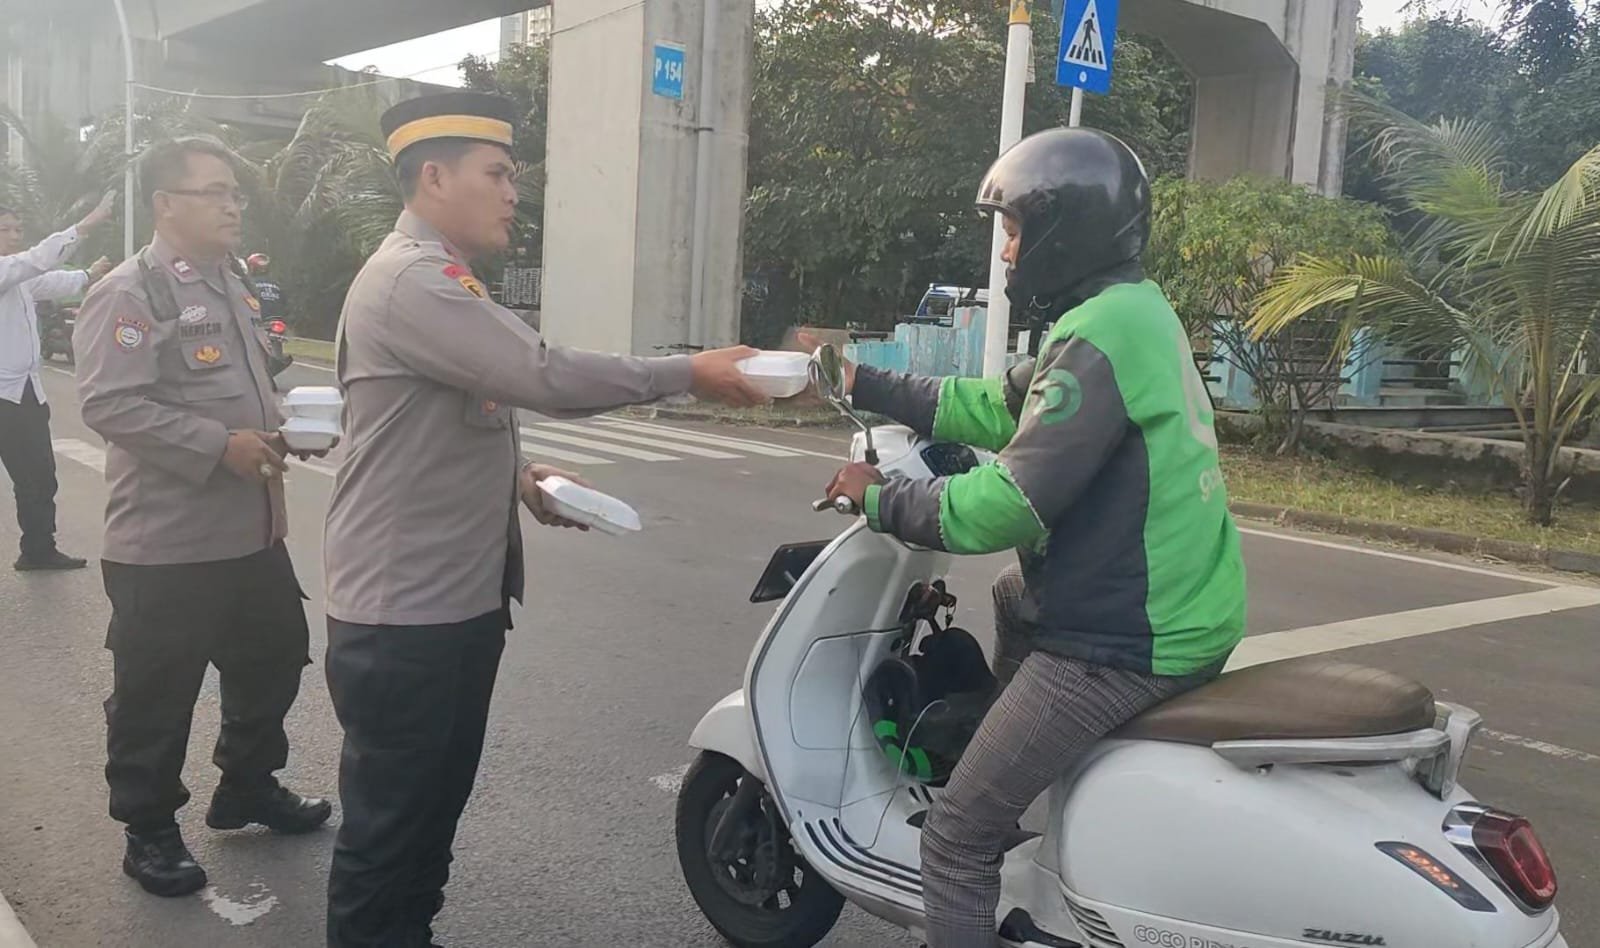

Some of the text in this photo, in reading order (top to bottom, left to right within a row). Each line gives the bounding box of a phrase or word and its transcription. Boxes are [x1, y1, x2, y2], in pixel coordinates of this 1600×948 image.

[655, 57, 682, 83] P 154
[1133, 924, 1186, 948] COCO
